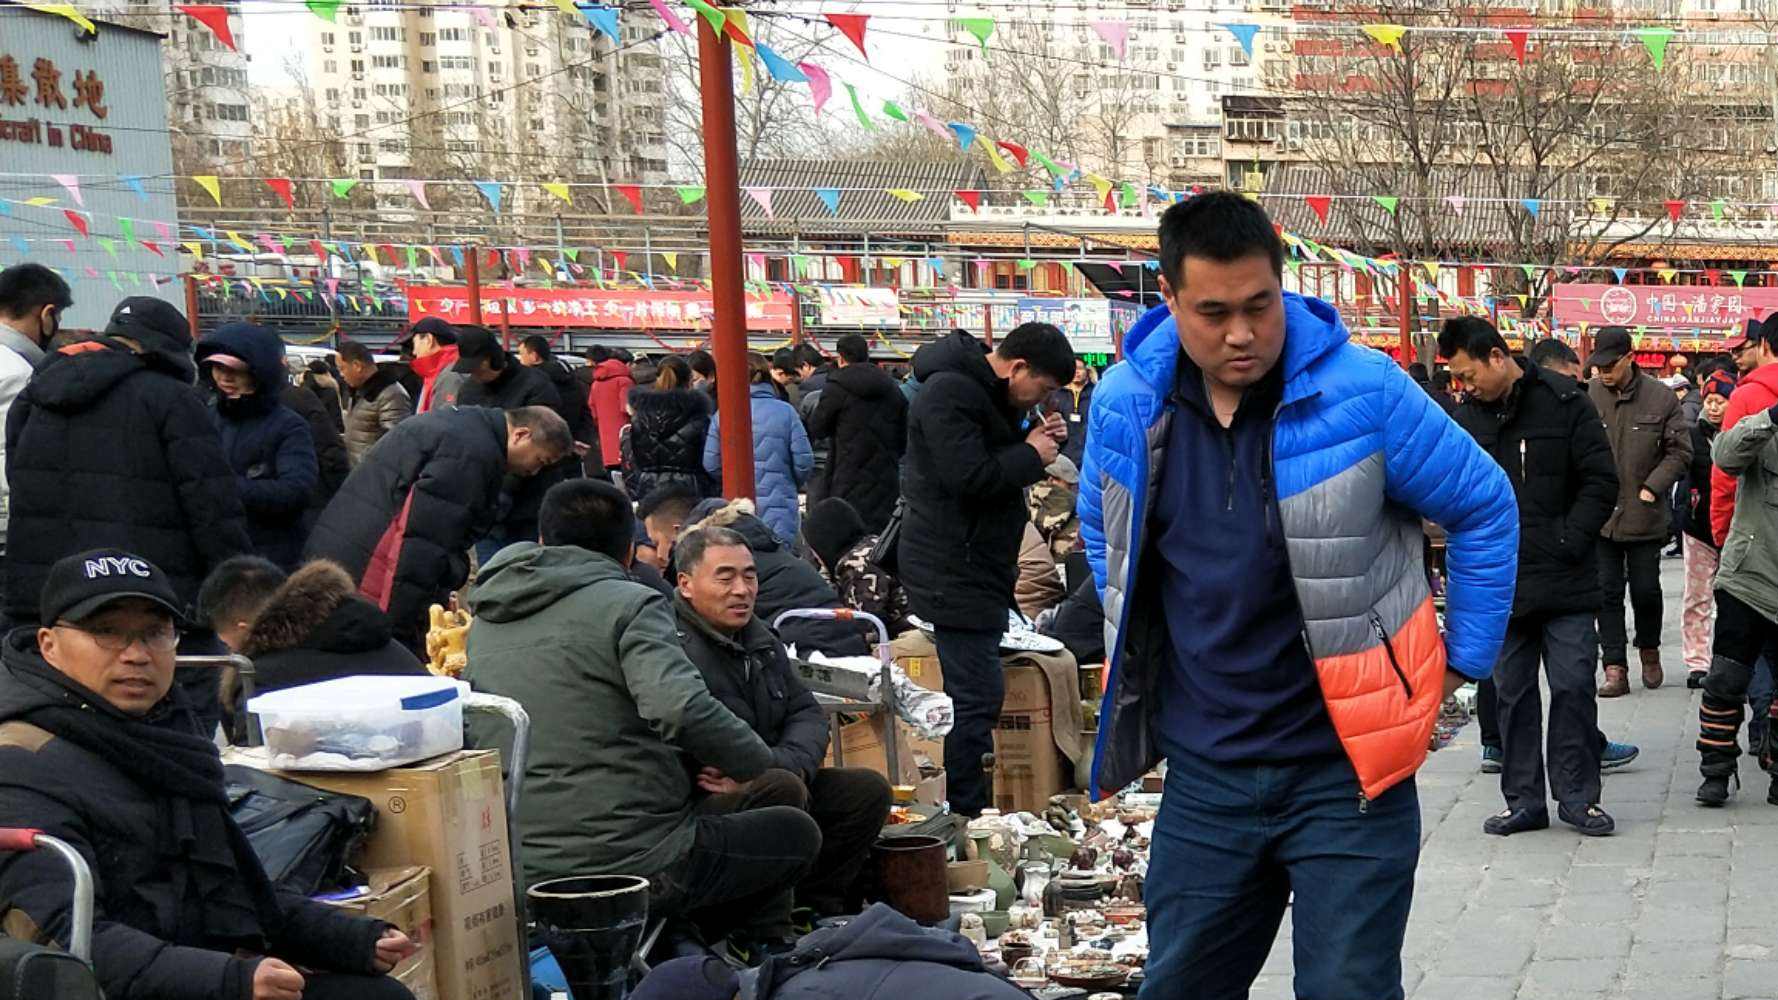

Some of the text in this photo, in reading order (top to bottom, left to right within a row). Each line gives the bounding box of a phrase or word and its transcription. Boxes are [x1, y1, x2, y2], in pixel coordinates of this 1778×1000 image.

[0, 54, 108, 119] 集散地
[47, 121, 63, 148] in
[70, 123, 113, 155] China
[85, 557, 150, 578] NYC
